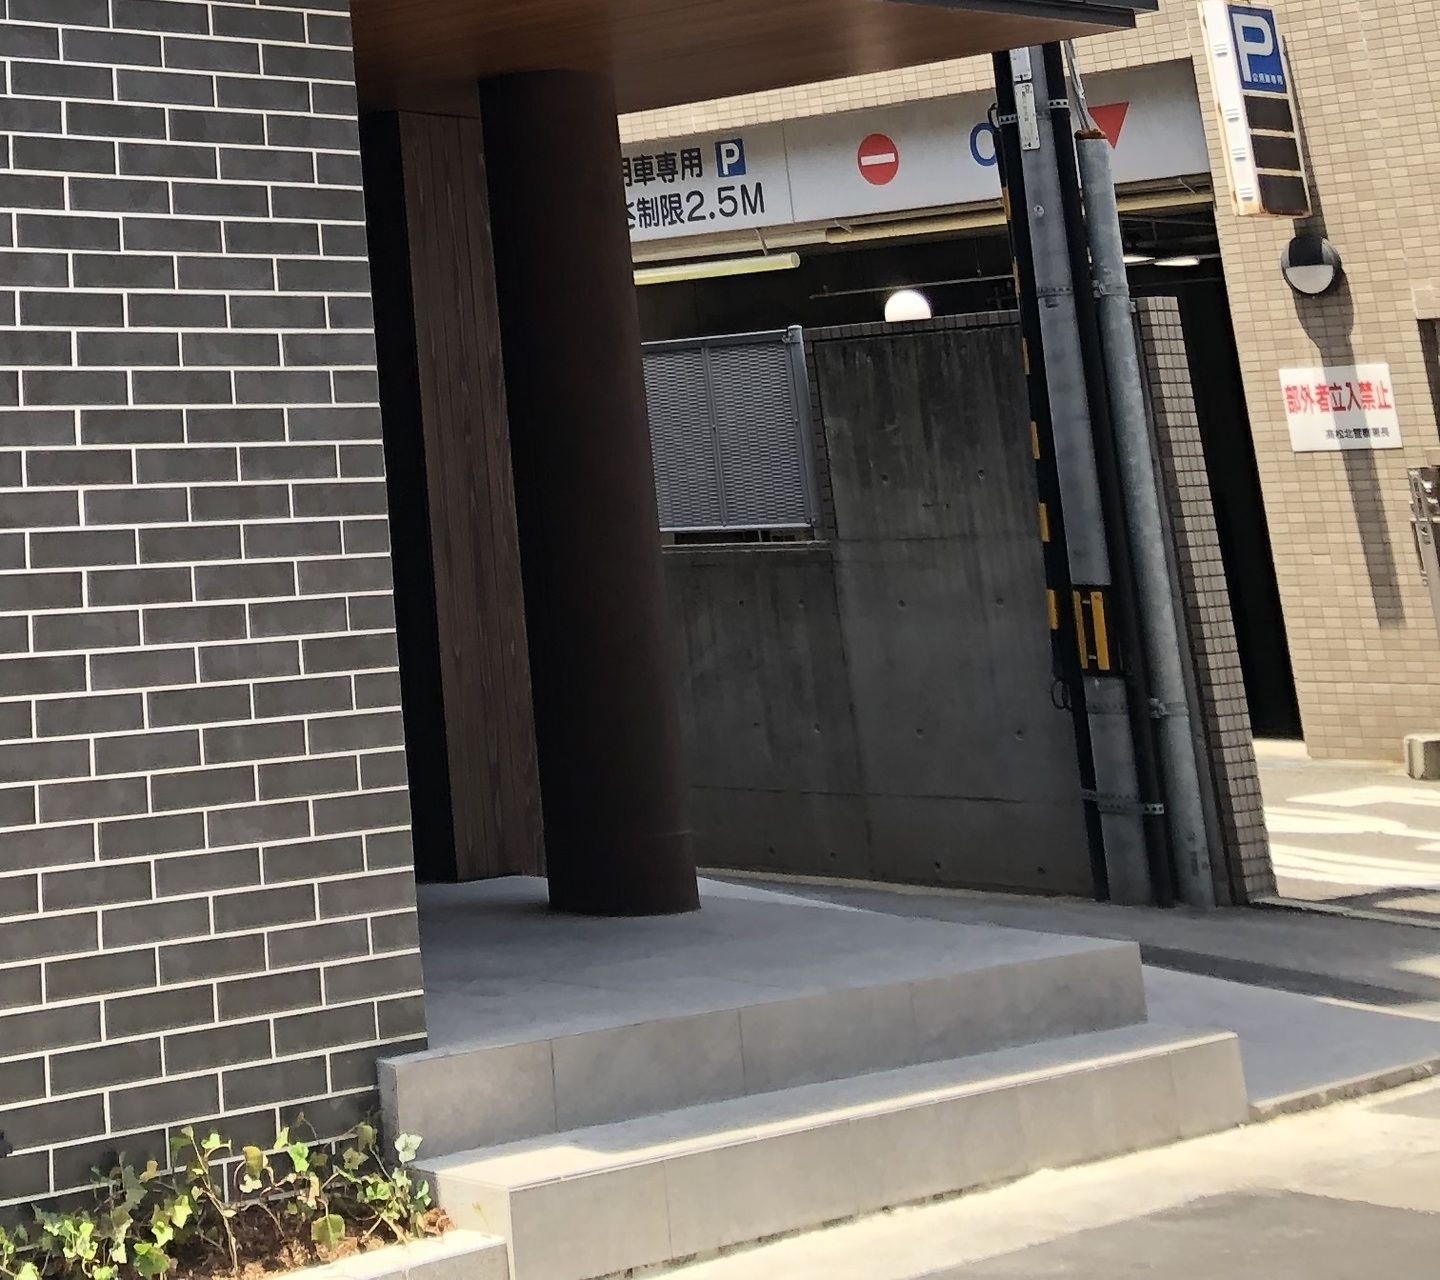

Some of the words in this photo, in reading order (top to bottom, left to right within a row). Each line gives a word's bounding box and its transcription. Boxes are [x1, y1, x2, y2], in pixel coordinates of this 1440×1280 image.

[1231, 13, 1274, 82] P
[719, 142, 742, 176] P
[1285, 381, 1392, 414] 部外者立入禁止
